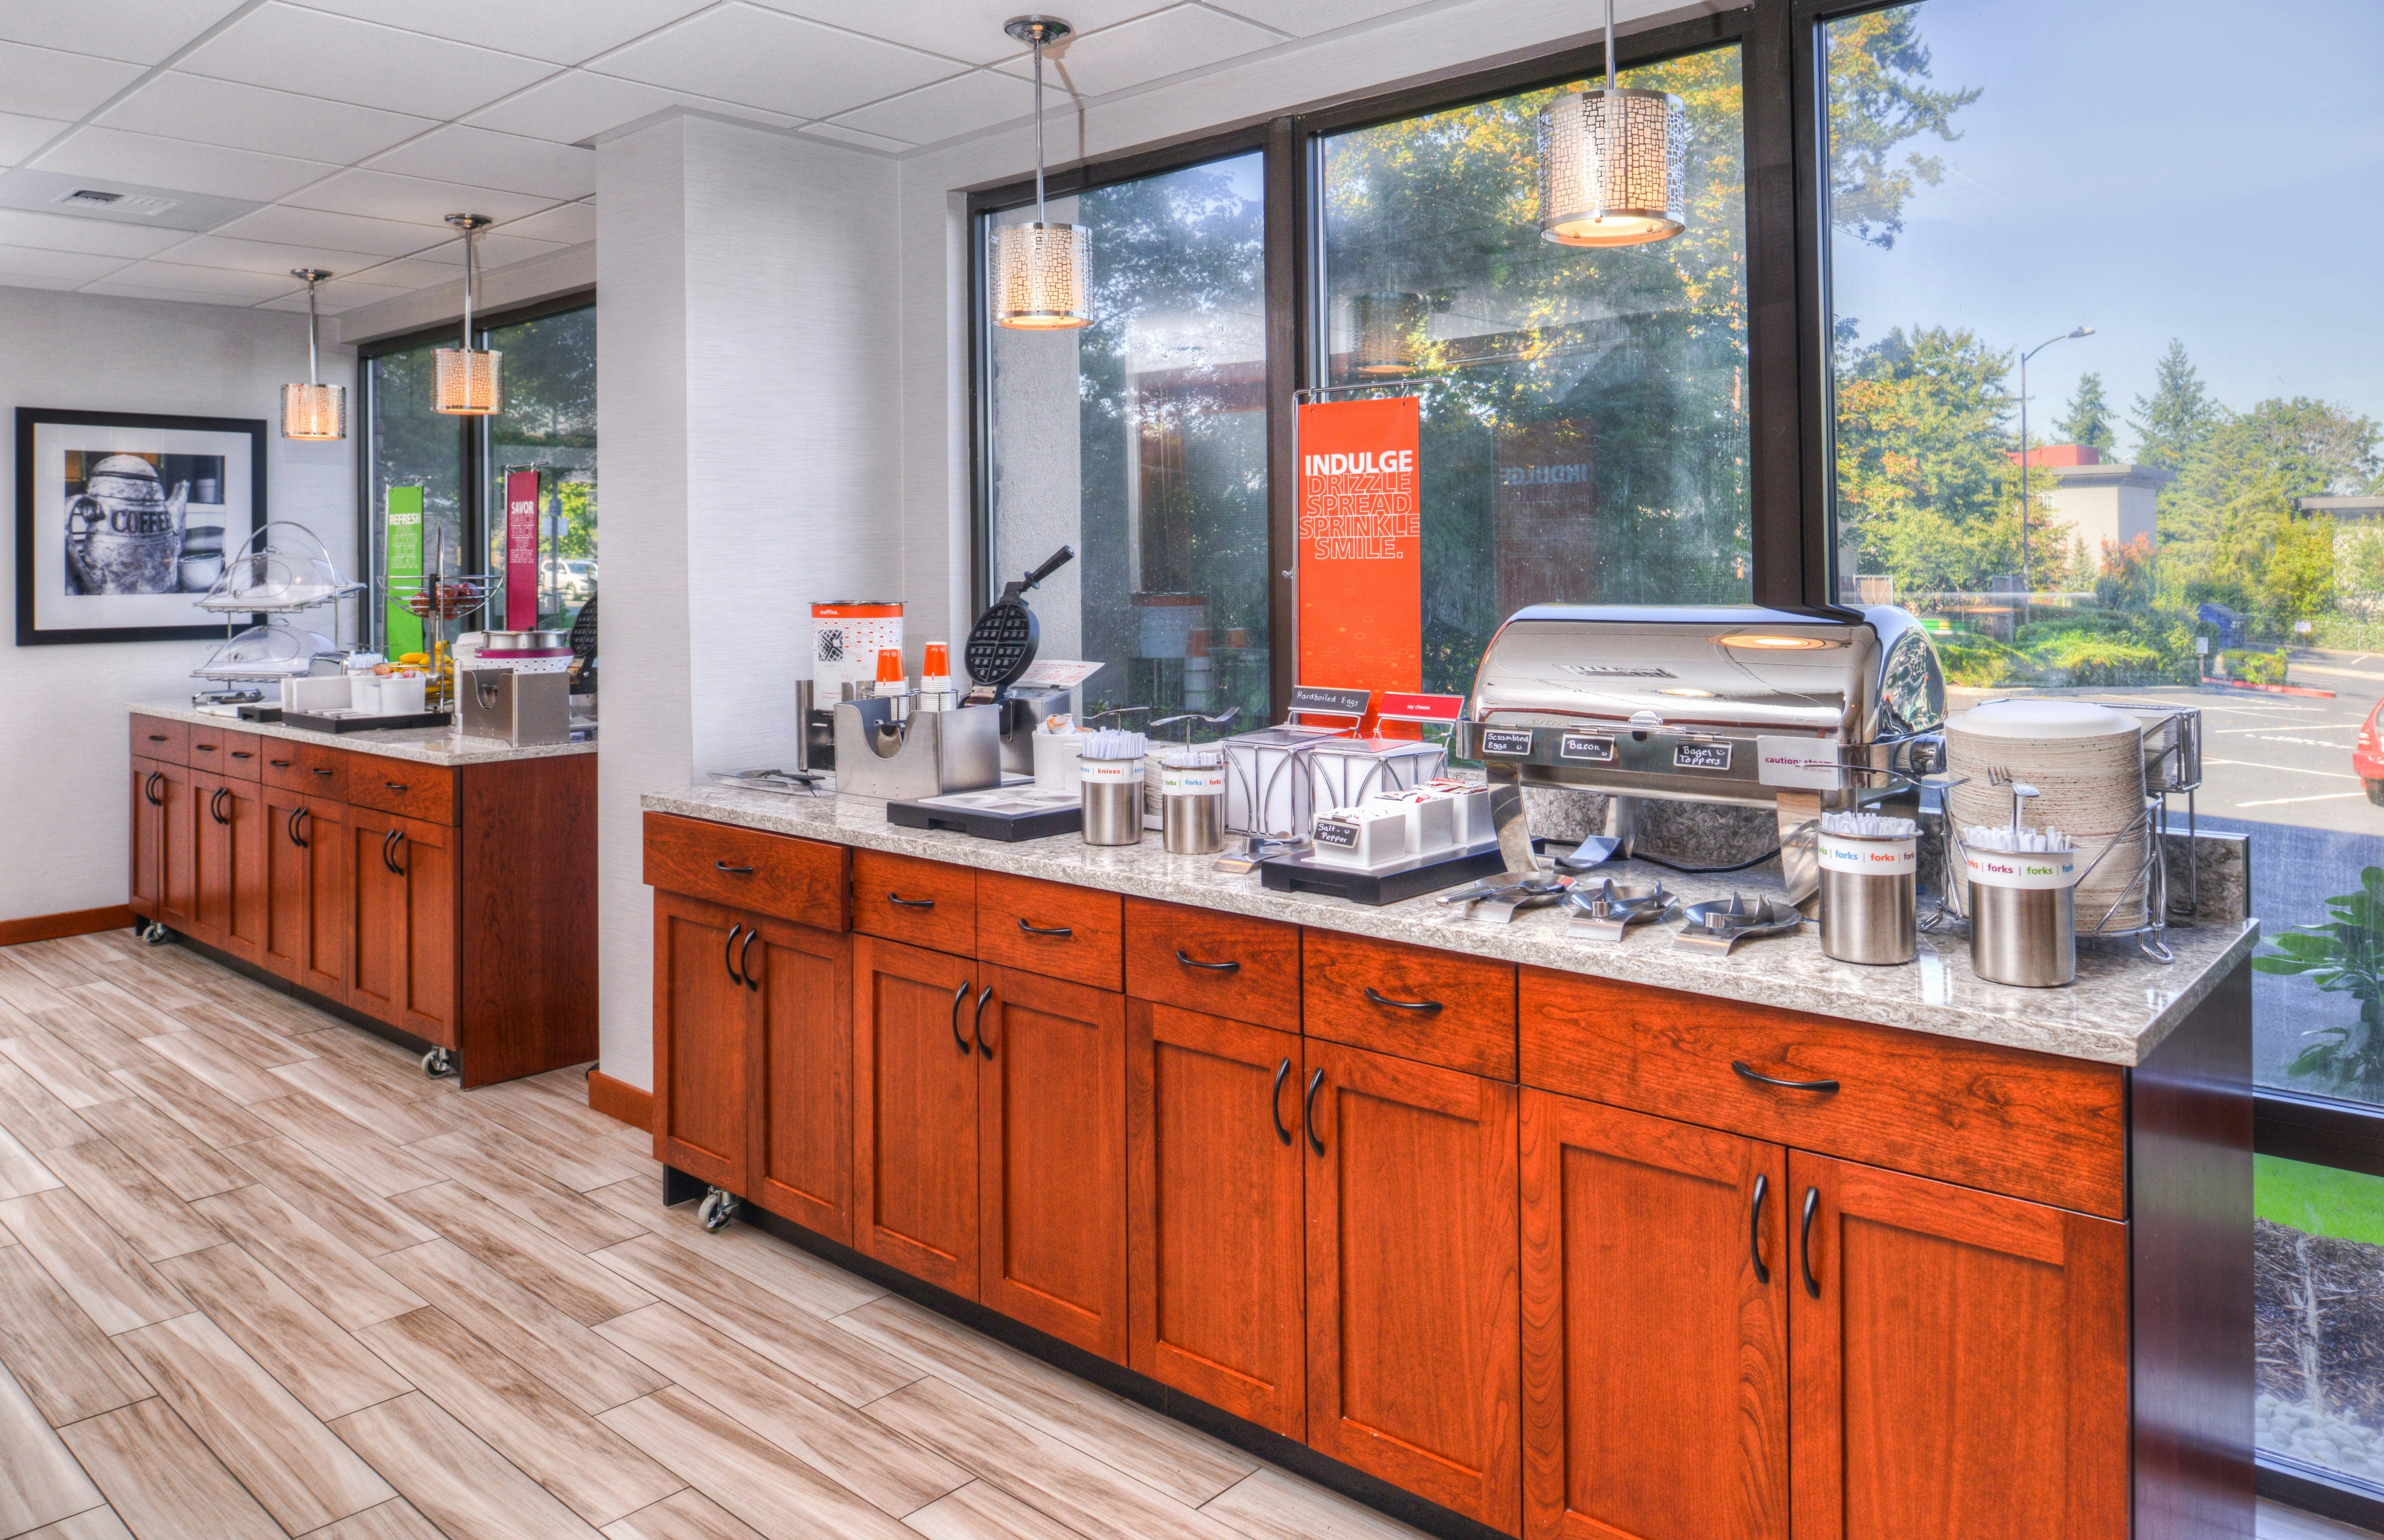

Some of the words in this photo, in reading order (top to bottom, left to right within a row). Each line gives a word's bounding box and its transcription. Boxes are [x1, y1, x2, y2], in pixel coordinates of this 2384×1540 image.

[1305, 450, 1413, 476] INDULGE
[1307, 471, 1411, 496] DRIZZLE
[511, 501, 534, 514] SAVOR
[1306, 493, 1412, 517] SPREAD
[389, 513, 420, 525] REFRESH
[511, 513, 534, 526] SMACK
[396, 525, 414, 534] PEEL
[511, 526, 533, 538] STACK
[1299, 513, 1420, 539] SPRINKLE
[393, 534, 418, 546] SCOOP
[516, 538, 529, 550] TOP
[395, 545, 416, 556] SLICE
[1315, 536, 1403, 560] SMILE.
[391, 556, 418, 568] RELAX.
[510, 550, 534, 563] ENJOY.
[1297, 691, 1336, 703] Hardboiled
[1341, 697, 1359, 708] Eggs
[1487, 733, 1529, 743] Scrambled
[1488, 741, 1507, 750] Eggs
[1567, 740, 1600, 751] Bacon
[1682, 746, 1712, 758] Bagel
[1679, 755, 1720, 765] Toppers
[1321, 832, 1347, 843] Pepper
[1835, 850, 1858, 860] forks
[1870, 853, 1895, 862] forks
[1988, 864, 2013, 874] forks
[2027, 866, 2053, 875] forks
